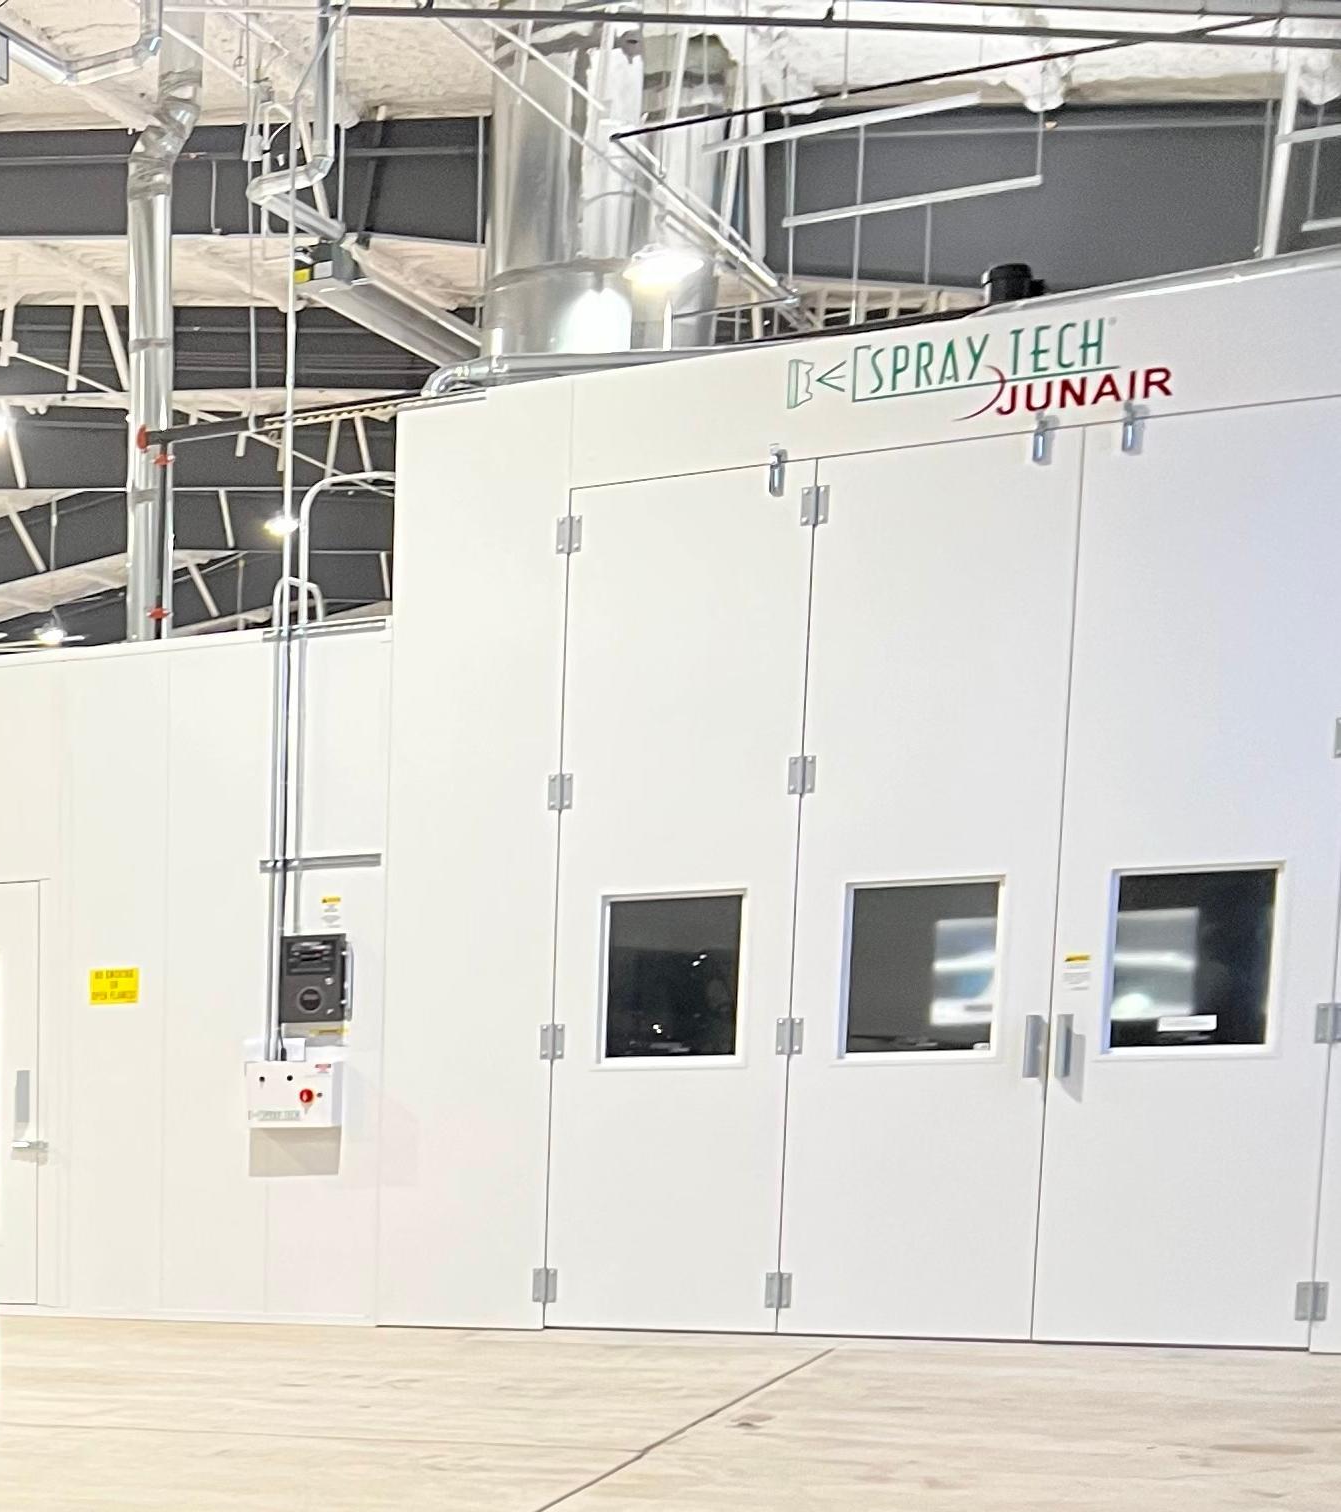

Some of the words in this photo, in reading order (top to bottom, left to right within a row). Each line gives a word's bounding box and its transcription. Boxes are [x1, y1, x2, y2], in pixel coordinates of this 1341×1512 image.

[870, 333, 990, 394] SPRAY
[1010, 318, 1105, 376] TECH
[995, 366, 1174, 416] JUNAIR
